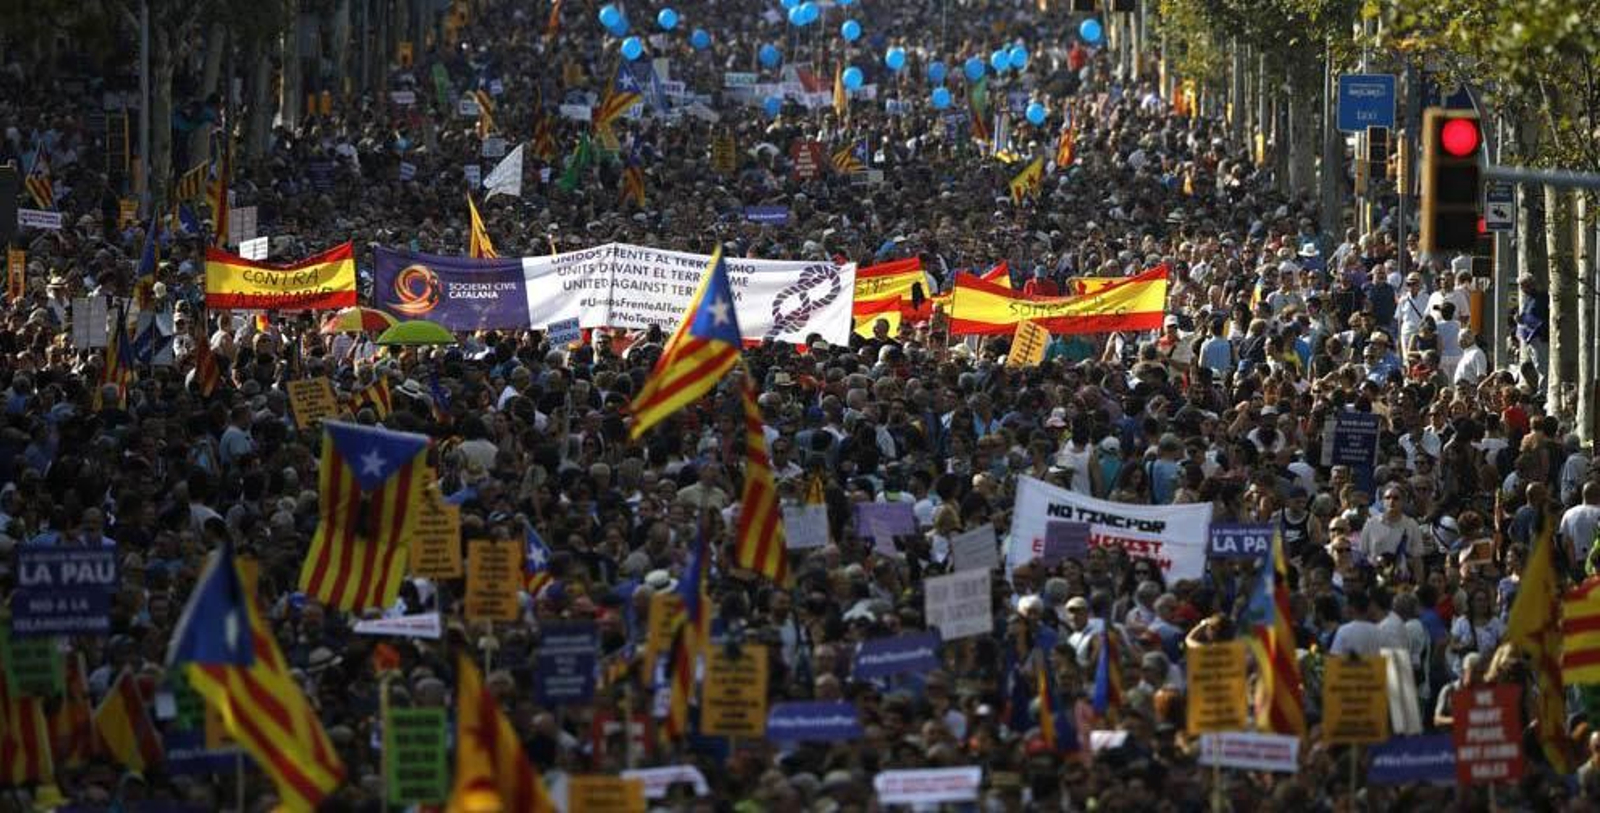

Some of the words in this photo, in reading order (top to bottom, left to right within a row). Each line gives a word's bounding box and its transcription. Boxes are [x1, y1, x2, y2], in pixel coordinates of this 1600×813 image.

[552, 249, 601, 264] UNIDOS
[605, 246, 651, 261] FRENTE
[655, 254, 670, 265] AL
[242, 268, 319, 285] CONTRA
[557, 263, 595, 276] UNITS
[653, 267, 666, 279] EL
[449, 282, 491, 291] SOCIETAT
[563, 279, 608, 291] UNITED
[611, 279, 667, 295] AGAINST
[449, 291, 499, 299] CATALANA
[1047, 502, 1072, 519] NO
[1076, 508, 1123, 528] TINC
[1126, 518, 1167, 534] POR
[1212, 536, 1238, 552] LA
[1243, 536, 1268, 552] PA
[20, 562, 52, 585] LA
[61, 561, 116, 584] PAU
